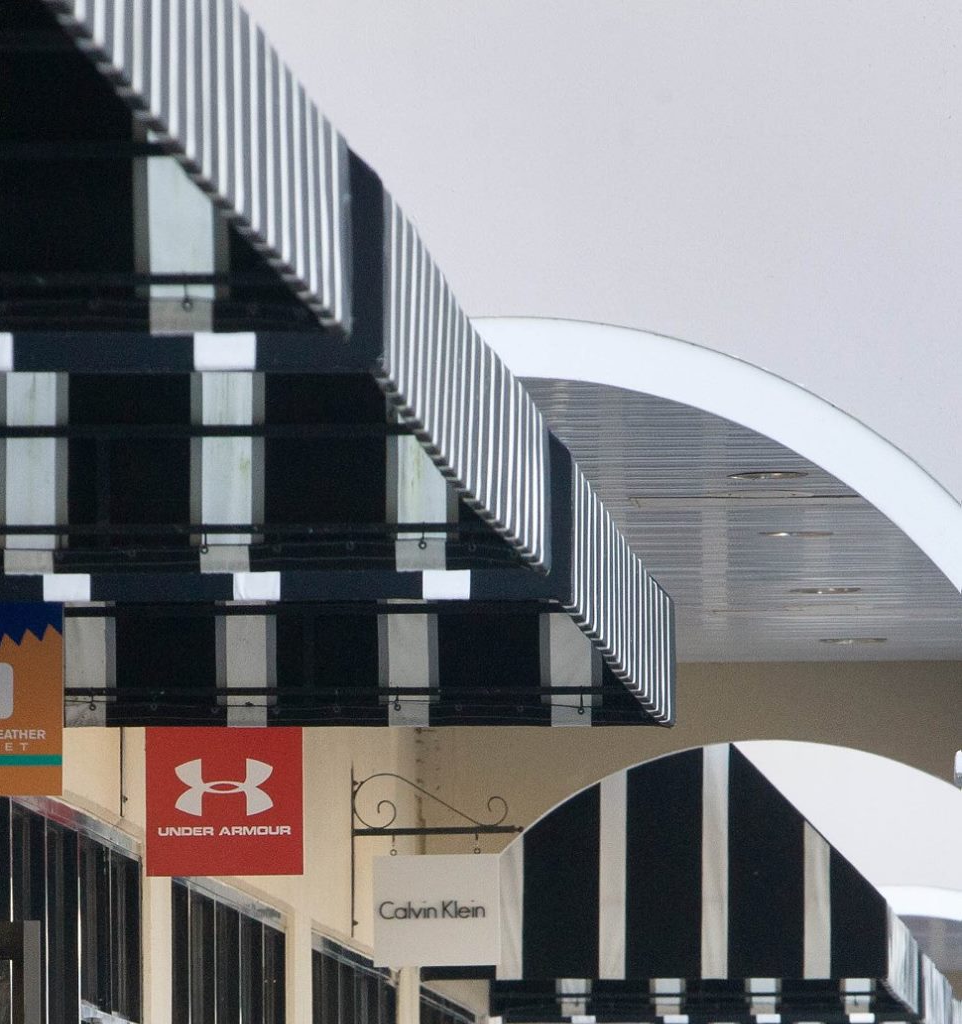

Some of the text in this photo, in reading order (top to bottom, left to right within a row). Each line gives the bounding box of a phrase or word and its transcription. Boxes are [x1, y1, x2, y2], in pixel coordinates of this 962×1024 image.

[157, 825, 292, 837] UNDER ARMOUR
[379, 899, 486, 920] Calvin Klein
